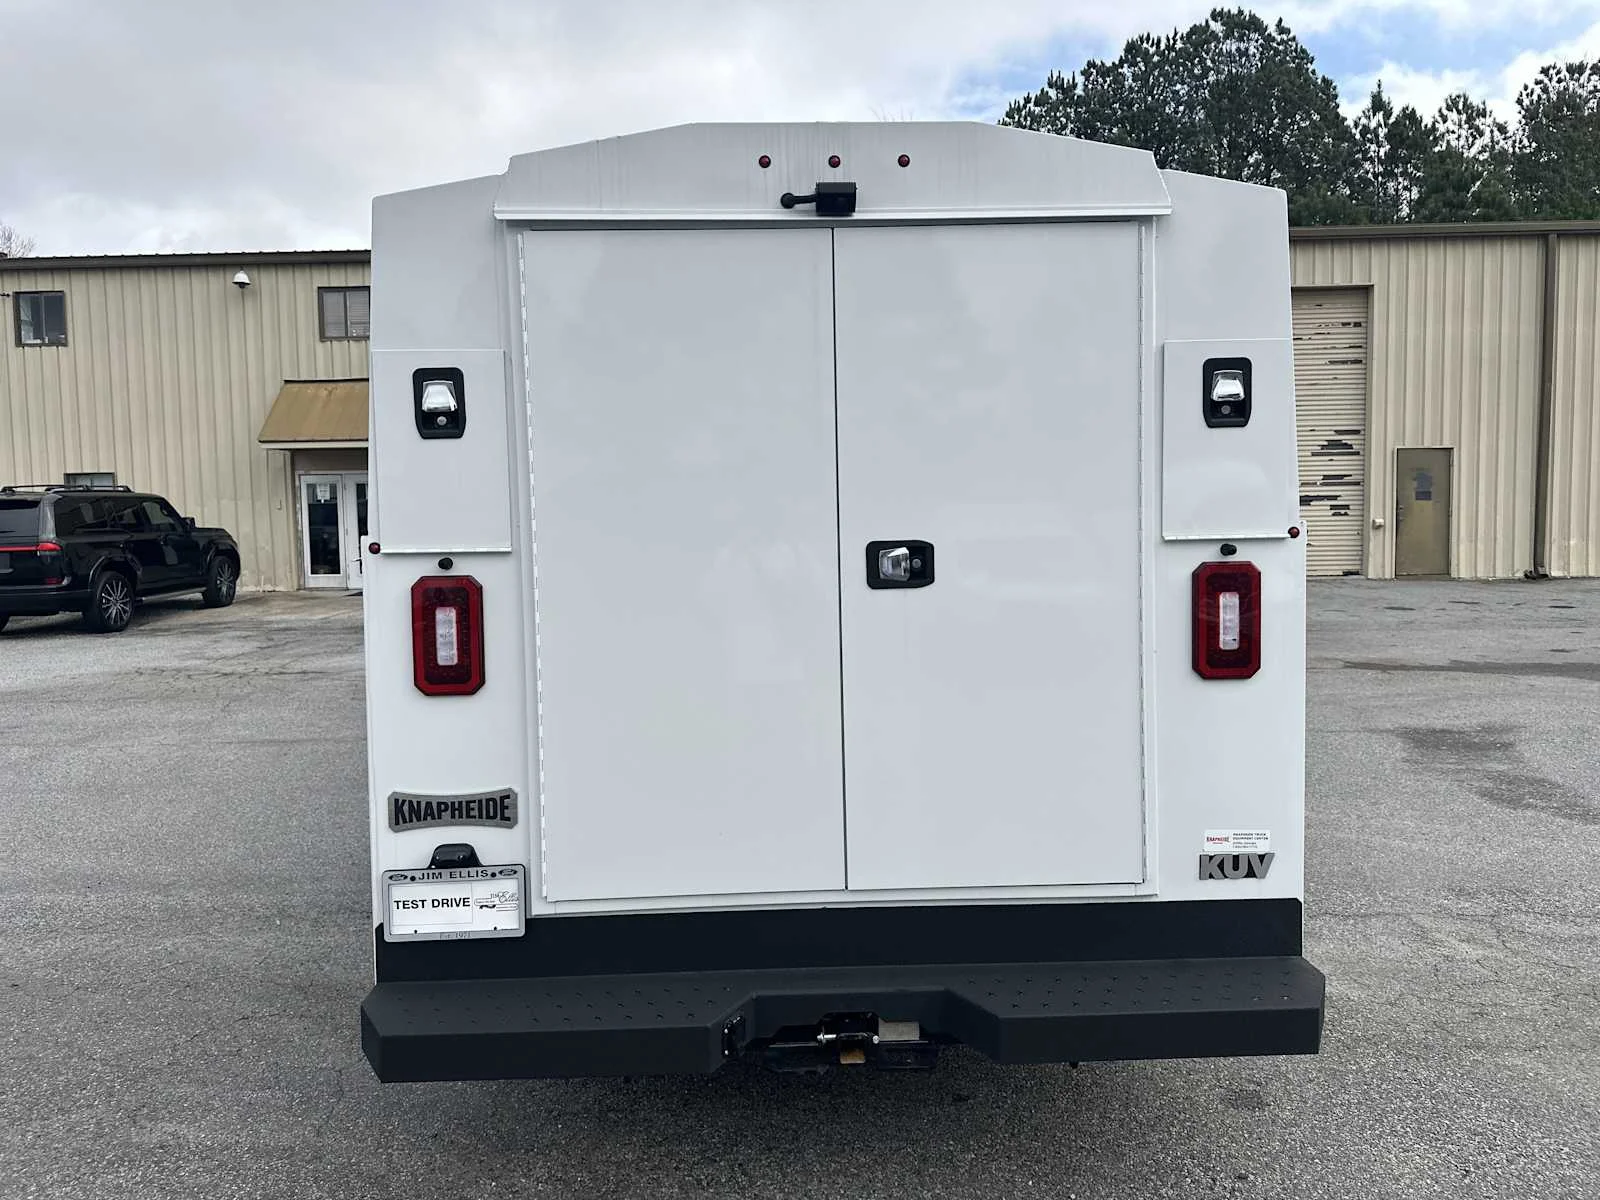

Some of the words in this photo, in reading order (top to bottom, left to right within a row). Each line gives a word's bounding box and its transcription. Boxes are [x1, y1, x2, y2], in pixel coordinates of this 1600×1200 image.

[393, 794, 512, 826] KNAPHEIDE
[418, 871, 443, 881] JIM
[449, 869, 489, 879] ELLIS
[1199, 853, 1275, 880] KUV
[393, 899, 427, 910] TEST
[431, 897, 471, 909] DRIVE
